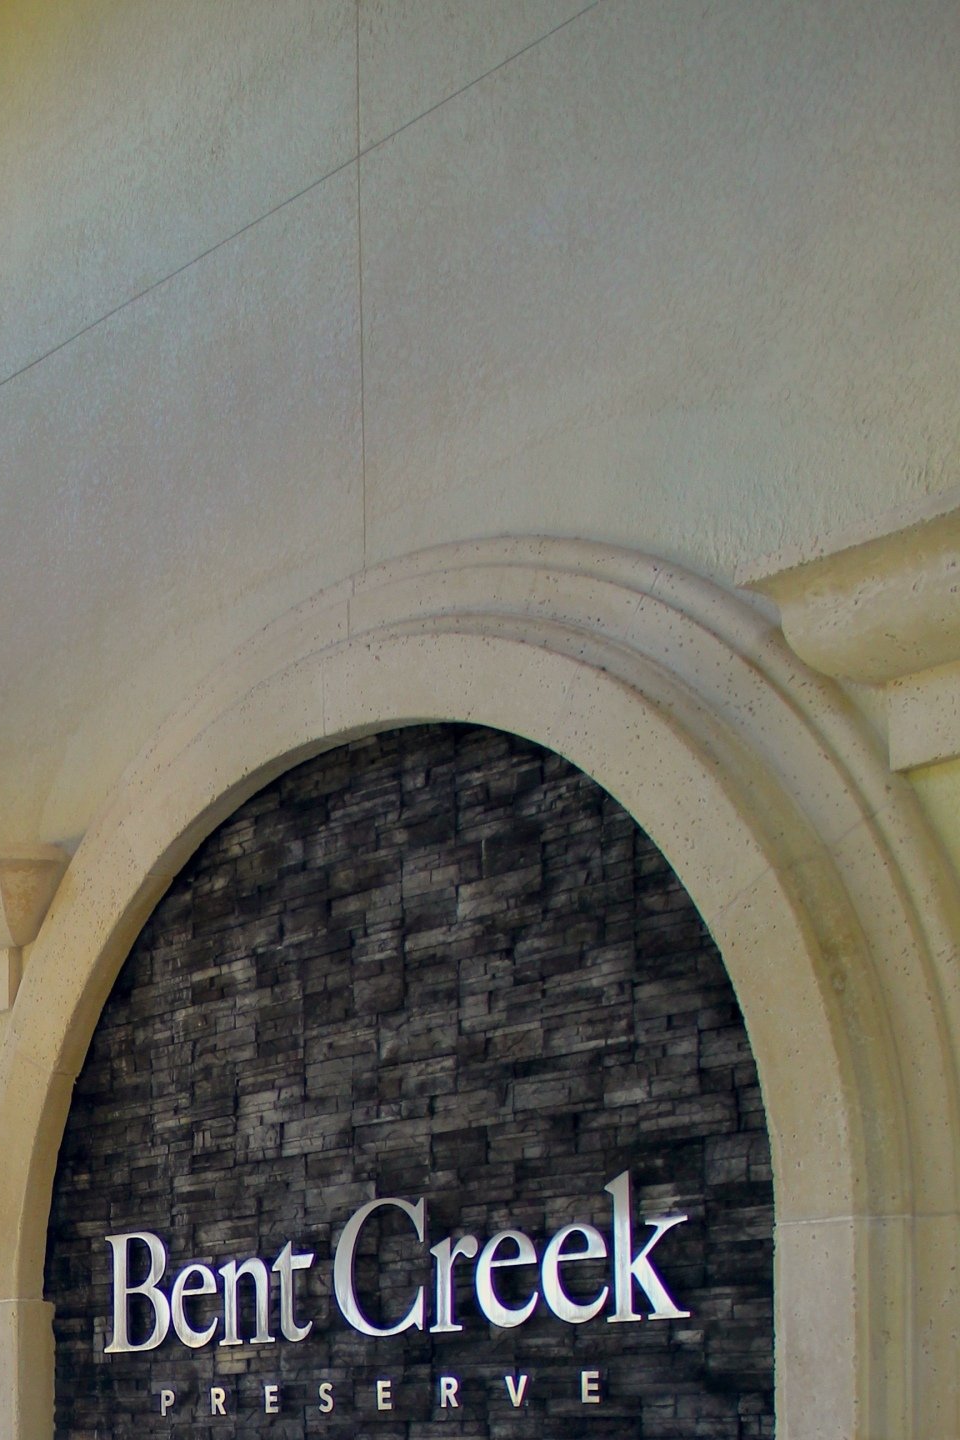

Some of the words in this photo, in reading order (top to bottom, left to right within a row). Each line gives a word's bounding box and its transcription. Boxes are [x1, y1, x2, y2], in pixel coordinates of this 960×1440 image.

[104, 1231, 314, 1354] Bent
[333, 1170, 691, 1338] Creek
[160, 1370, 601, 1417] PRESERVE
